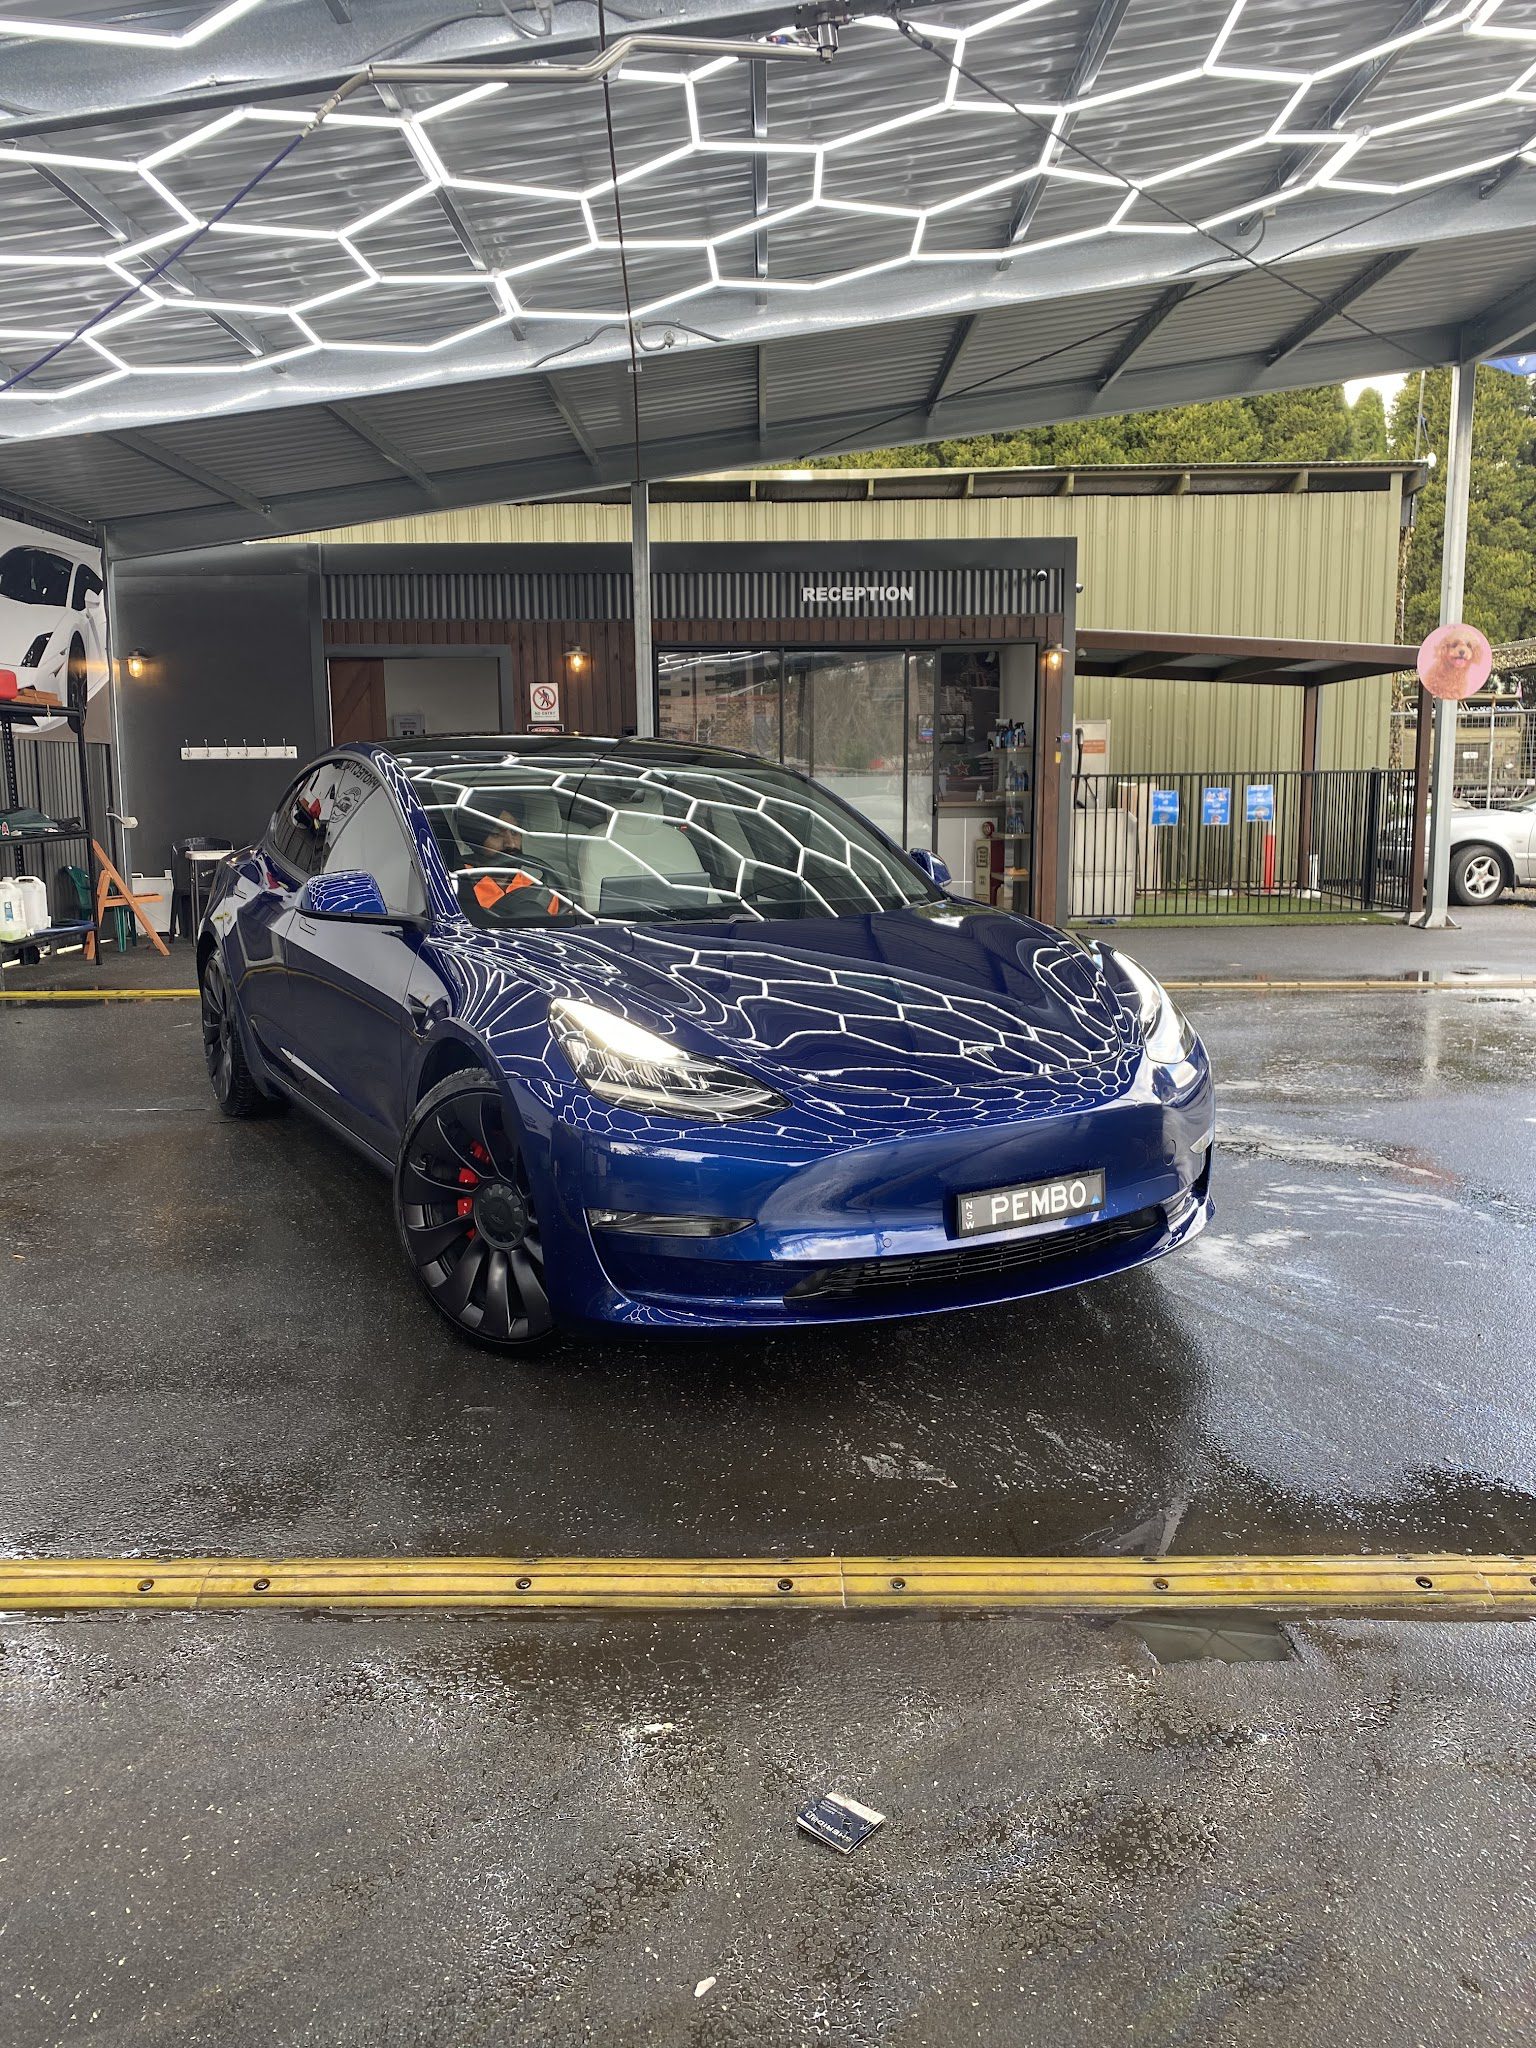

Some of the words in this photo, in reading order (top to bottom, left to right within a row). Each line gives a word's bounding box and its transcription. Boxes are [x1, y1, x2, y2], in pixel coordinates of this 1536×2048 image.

[802, 586, 914, 602] RECEPTION
[965, 1201, 975, 1229] NSW
[991, 1180, 1087, 1225] PEMBO
